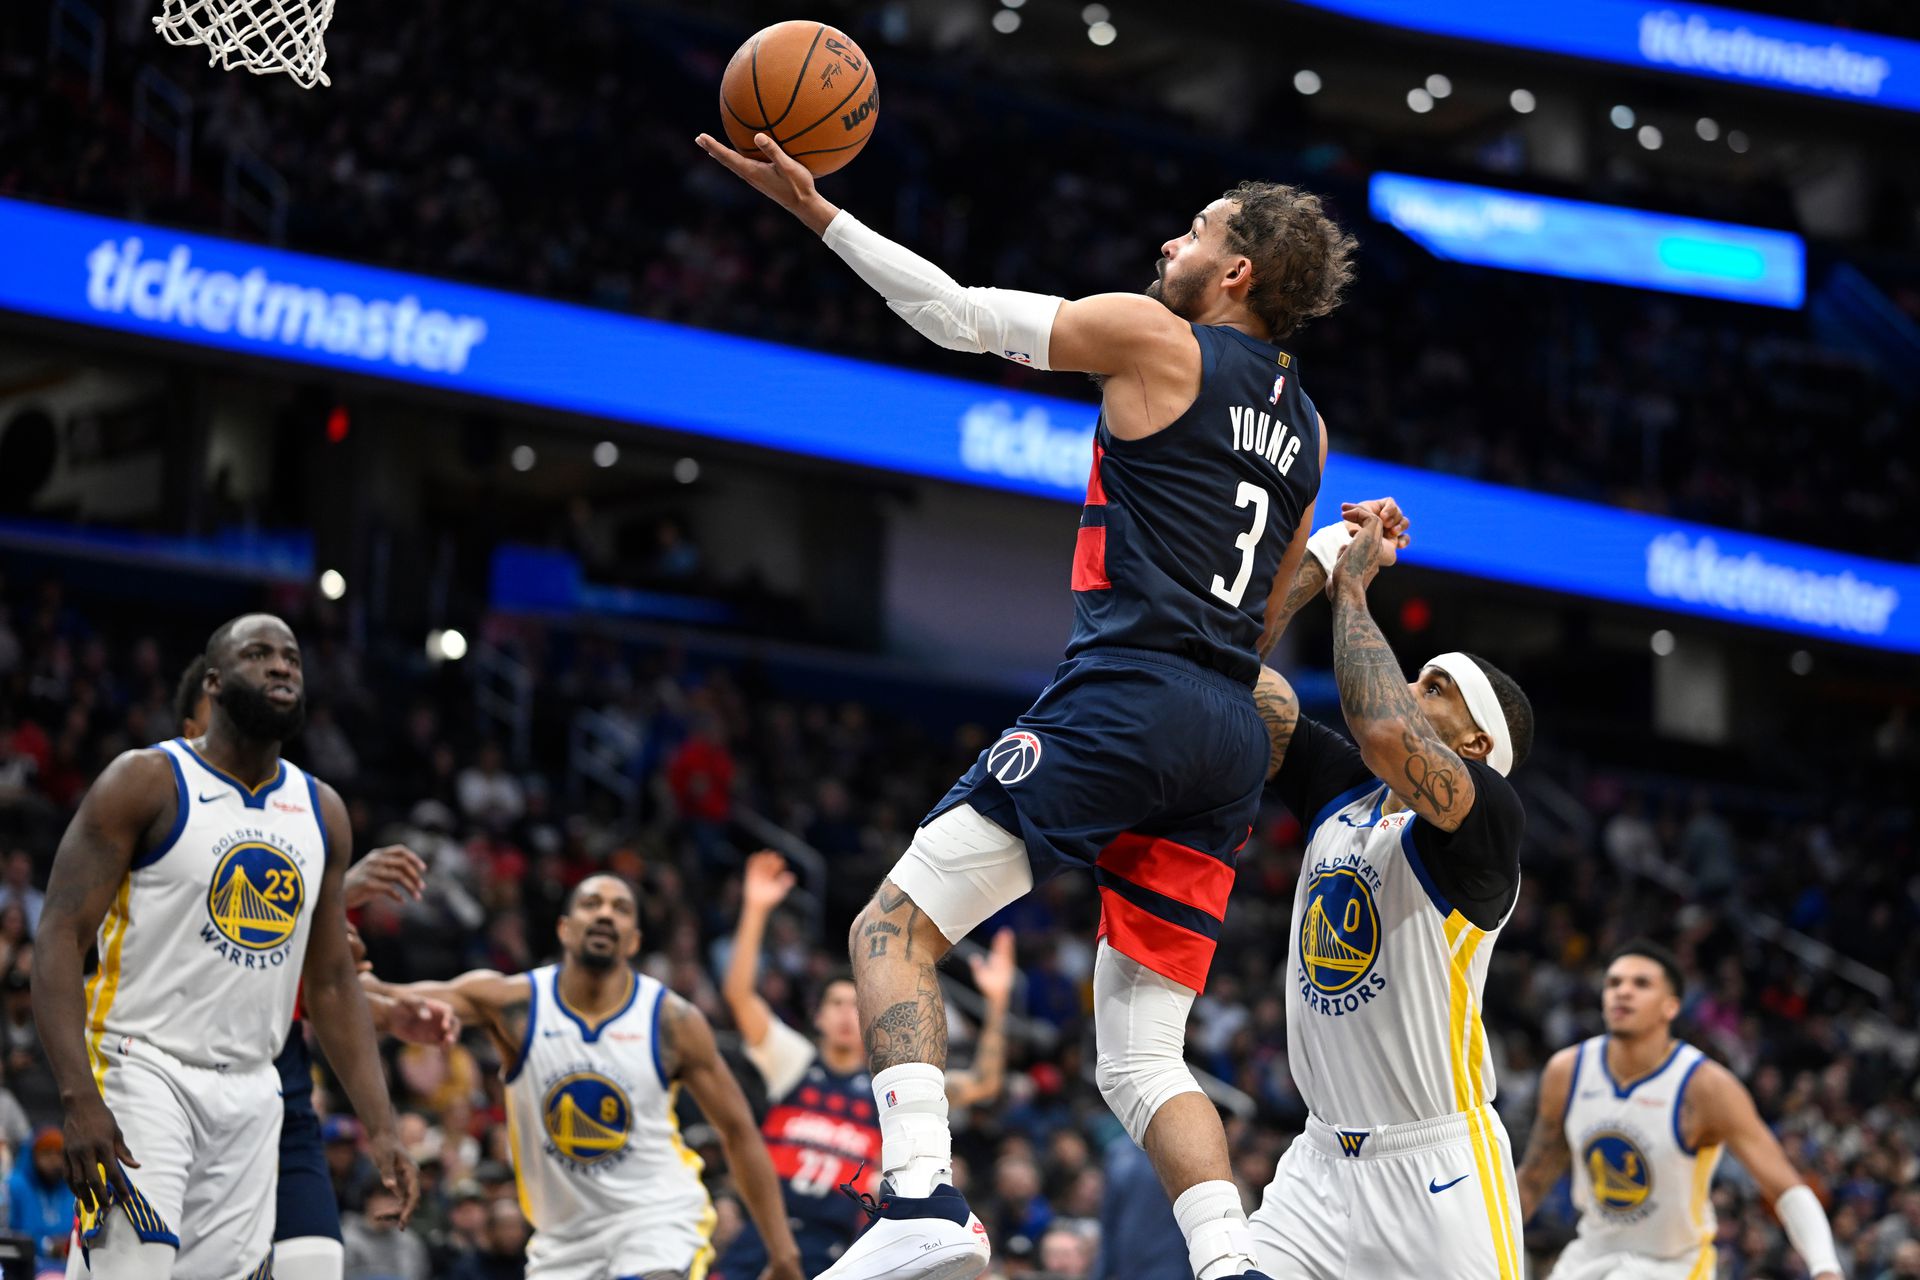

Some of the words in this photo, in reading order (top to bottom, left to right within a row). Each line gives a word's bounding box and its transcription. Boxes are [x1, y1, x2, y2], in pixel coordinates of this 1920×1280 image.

[86, 236, 488, 375] ticketmaster
[1229, 406, 1301, 477] YOUNG
[1210, 480, 1269, 608] 3
[1646, 531, 1899, 636] ticketmaster
[212, 828, 264, 857] GOLDEN
[263, 868, 296, 902] 23
[1343, 898, 1361, 933] 0
[200, 922, 291, 970] WARRIO
